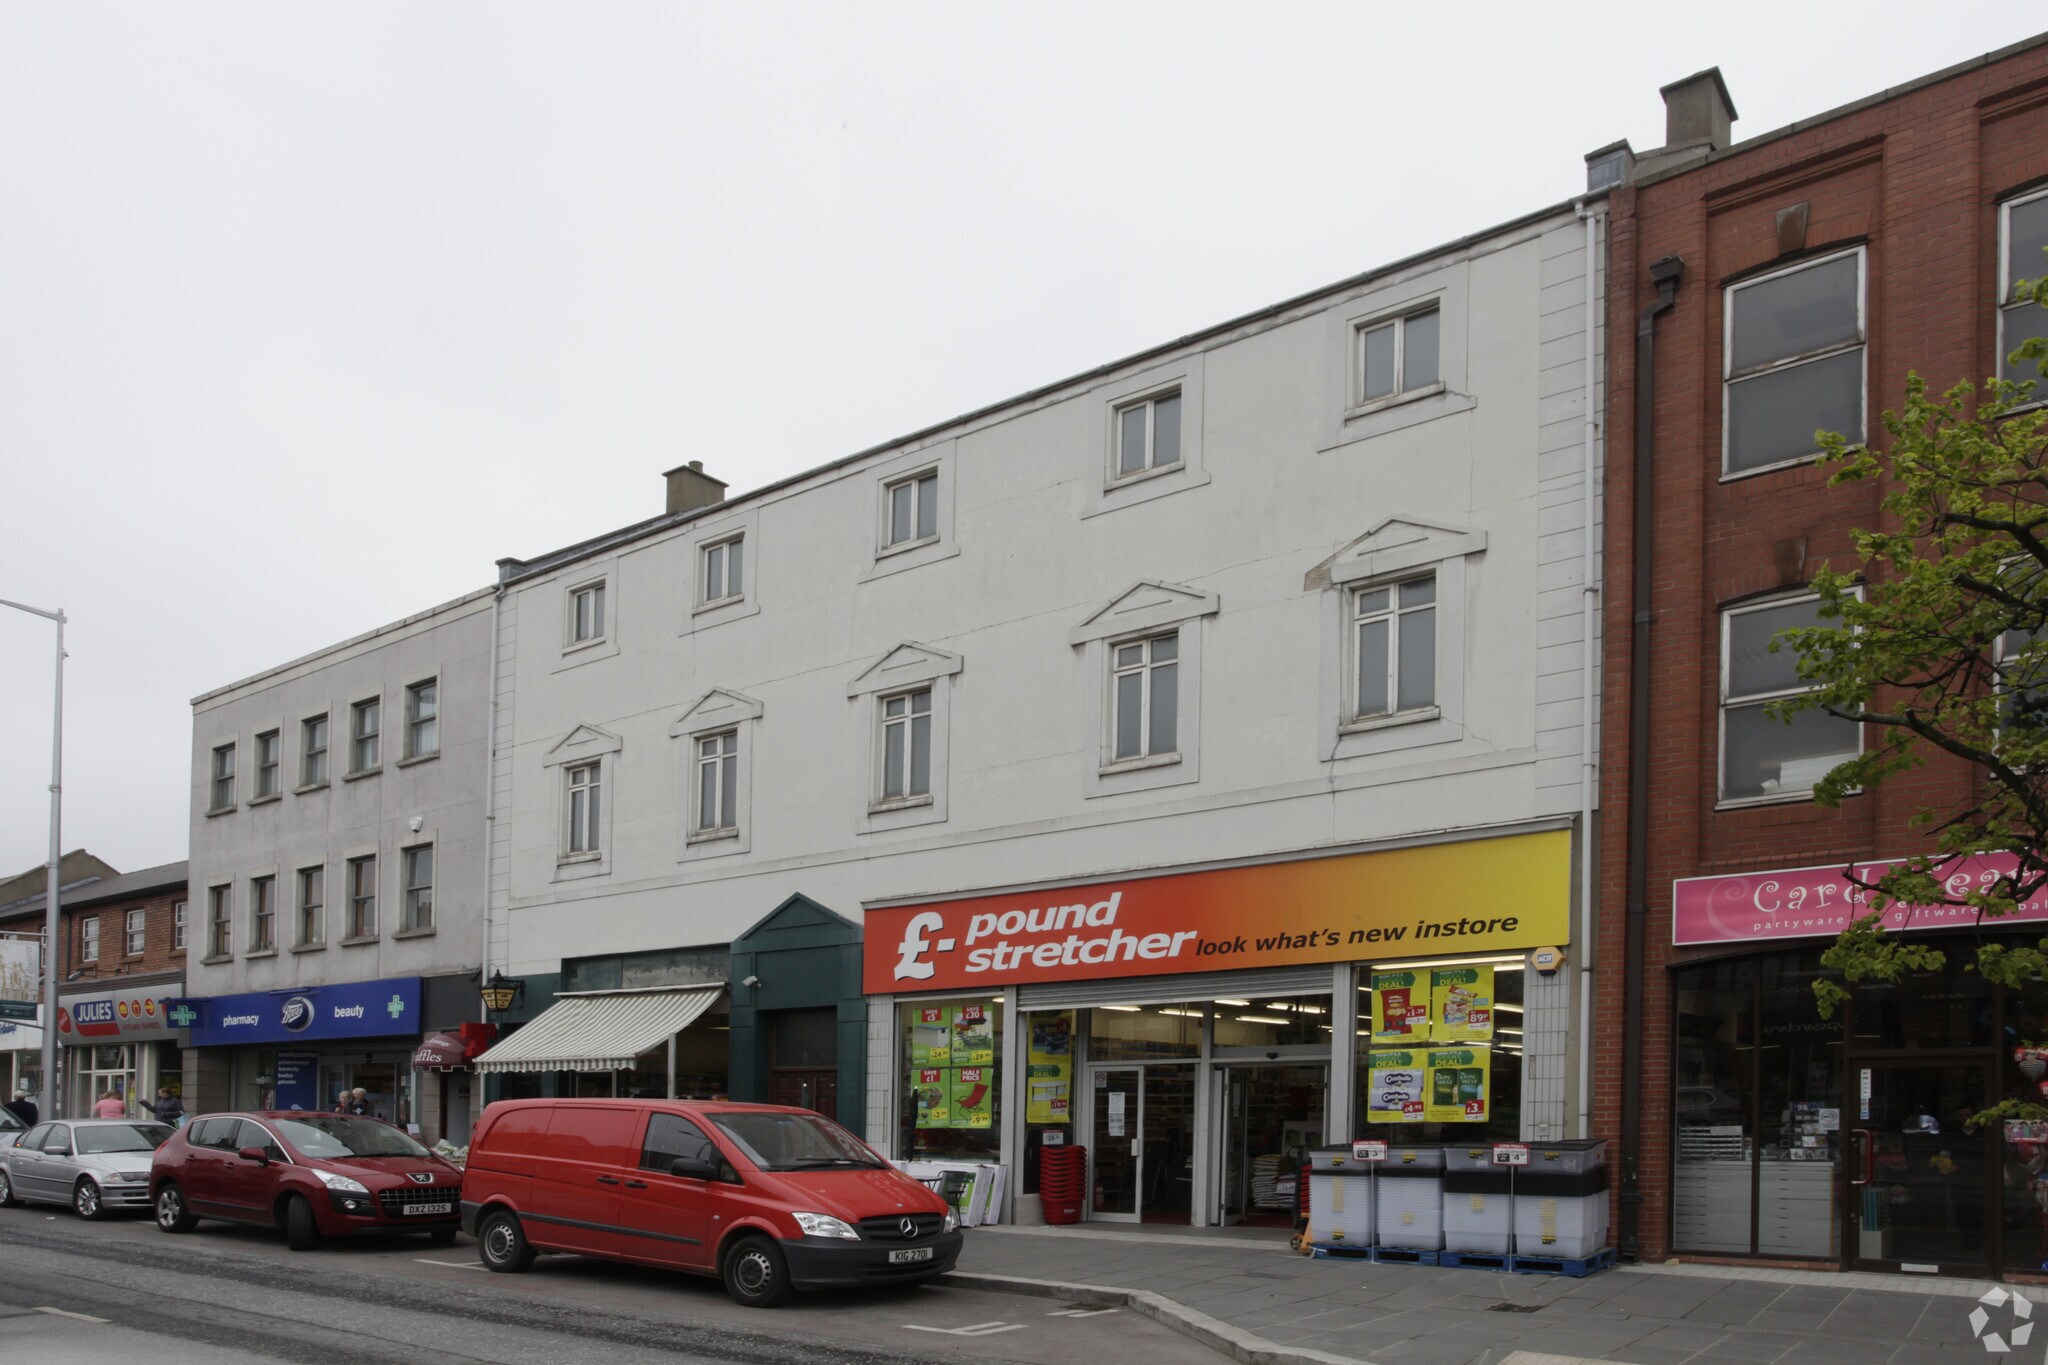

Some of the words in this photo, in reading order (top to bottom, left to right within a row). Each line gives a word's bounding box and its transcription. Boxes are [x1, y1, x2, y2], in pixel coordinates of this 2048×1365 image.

[1754, 868, 1871, 913] Card
[965, 892, 1122, 946] pound
[1754, 916, 1844, 931] partyware
[965, 929, 1197, 973] stretcher
[1196, 939, 1247, 956] look
[1256, 929, 1340, 951] what's
[1348, 926, 1408, 945] new
[1415, 917, 1519, 940] instore
[1379, 981, 1404, 989] DEAL!
[1440, 978, 1466, 986] DEAL!
[78, 1002, 112, 1022] JULIES
[223, 1014, 259, 1028] pharmacy
[334, 1005, 364, 1019] beauty
[1376, 1060, 1401, 1068] DEAL!
[1436, 1059, 1462, 1067] DEAL!
[1467, 1103, 1479, 1113] £3
[409, 1205, 425, 1214] DXZ
[428, 1204, 447, 1213] 1325
[895, 1251, 909, 1261] KIG
